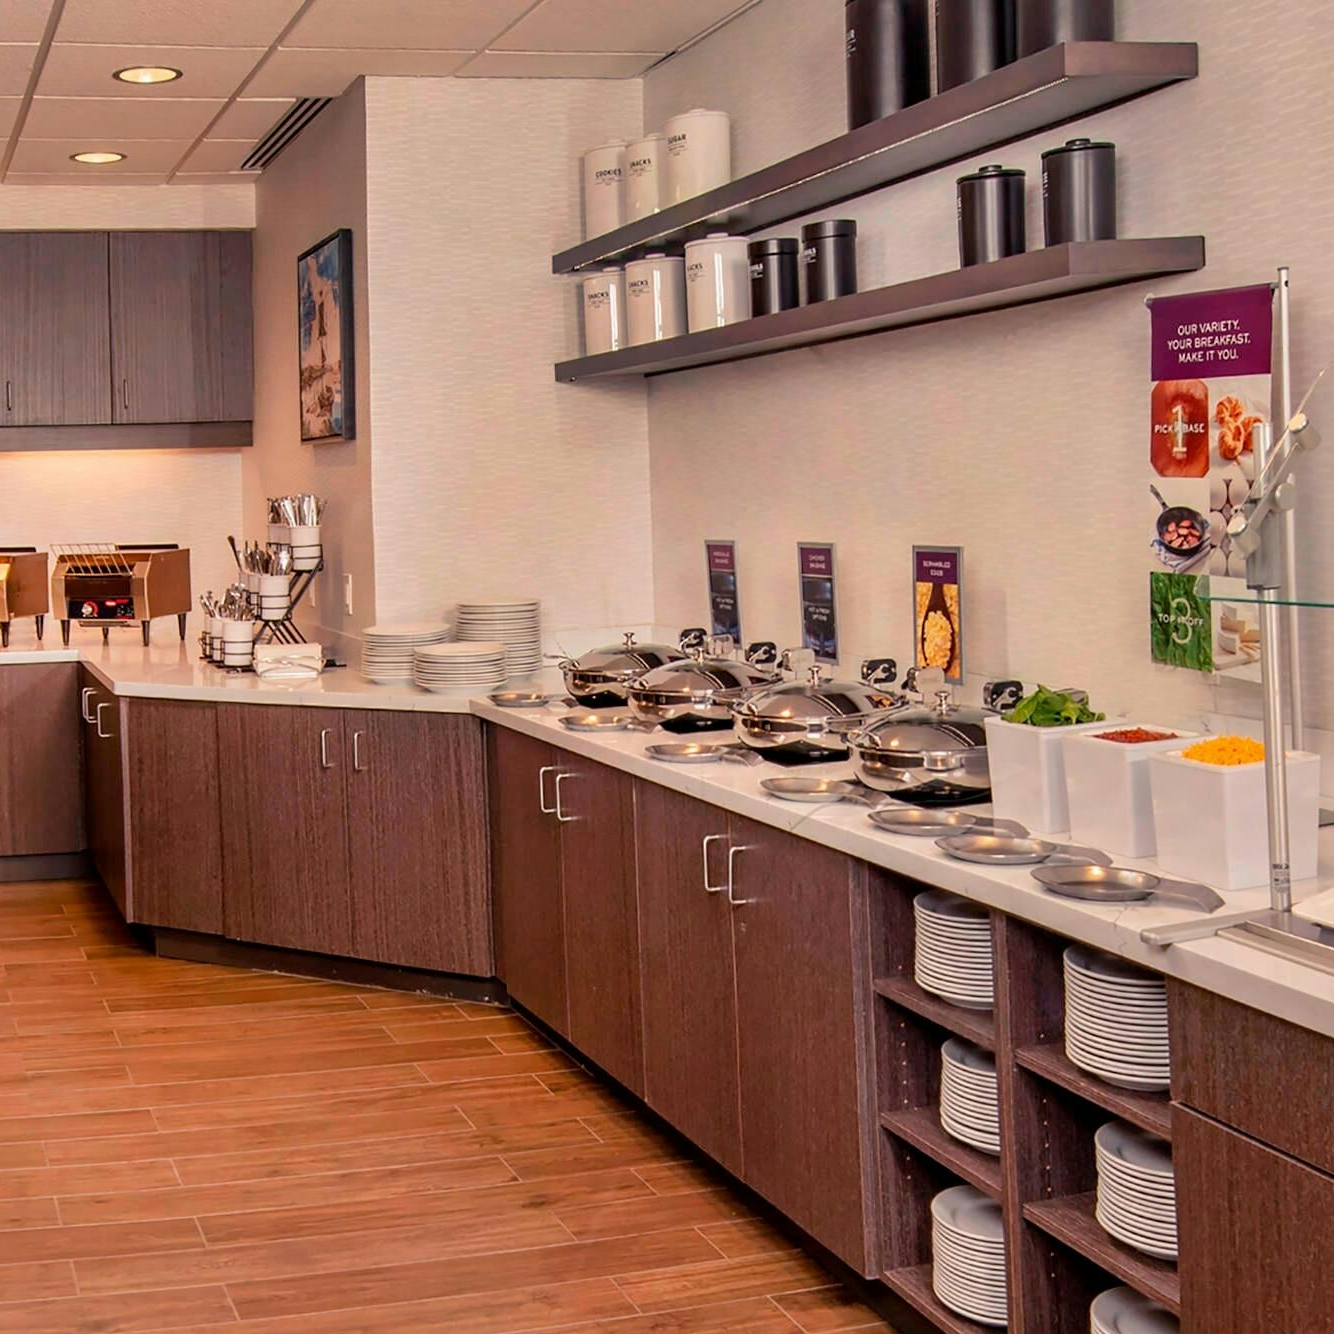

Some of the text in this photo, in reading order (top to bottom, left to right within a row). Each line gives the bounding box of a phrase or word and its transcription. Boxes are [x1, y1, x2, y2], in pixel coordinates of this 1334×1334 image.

[1177, 319, 1240, 336] OUR VARIETY.
[1167, 332, 1251, 350] YOUR BREAKFAST.
[1178, 349, 1239, 363] MAKE IT YOU.
[1154, 424, 1173, 434] PICK
[1172, 404, 1187, 452] 1
[1158, 613, 1175, 623] TOP
[1171, 597, 1192, 644] 3
